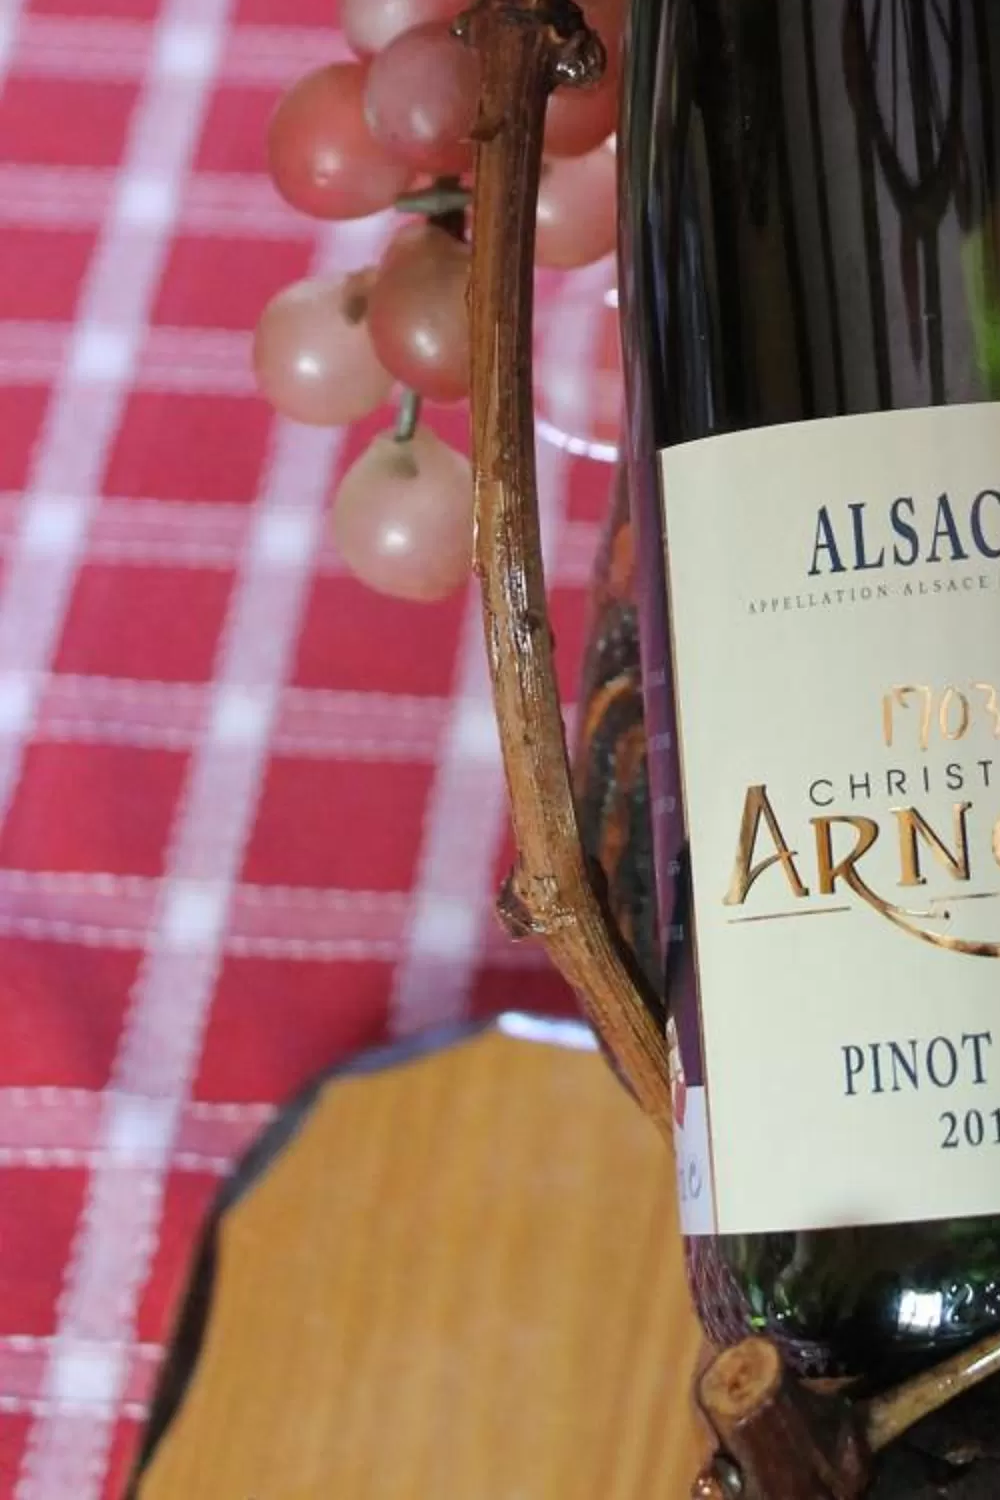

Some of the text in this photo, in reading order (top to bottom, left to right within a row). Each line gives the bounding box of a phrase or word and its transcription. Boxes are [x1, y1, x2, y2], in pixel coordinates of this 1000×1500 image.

[748, 583, 888, 614] APPELLATION
[903, 575, 988, 597] ALSACE
[842, 1032, 992, 1096] PINOT
